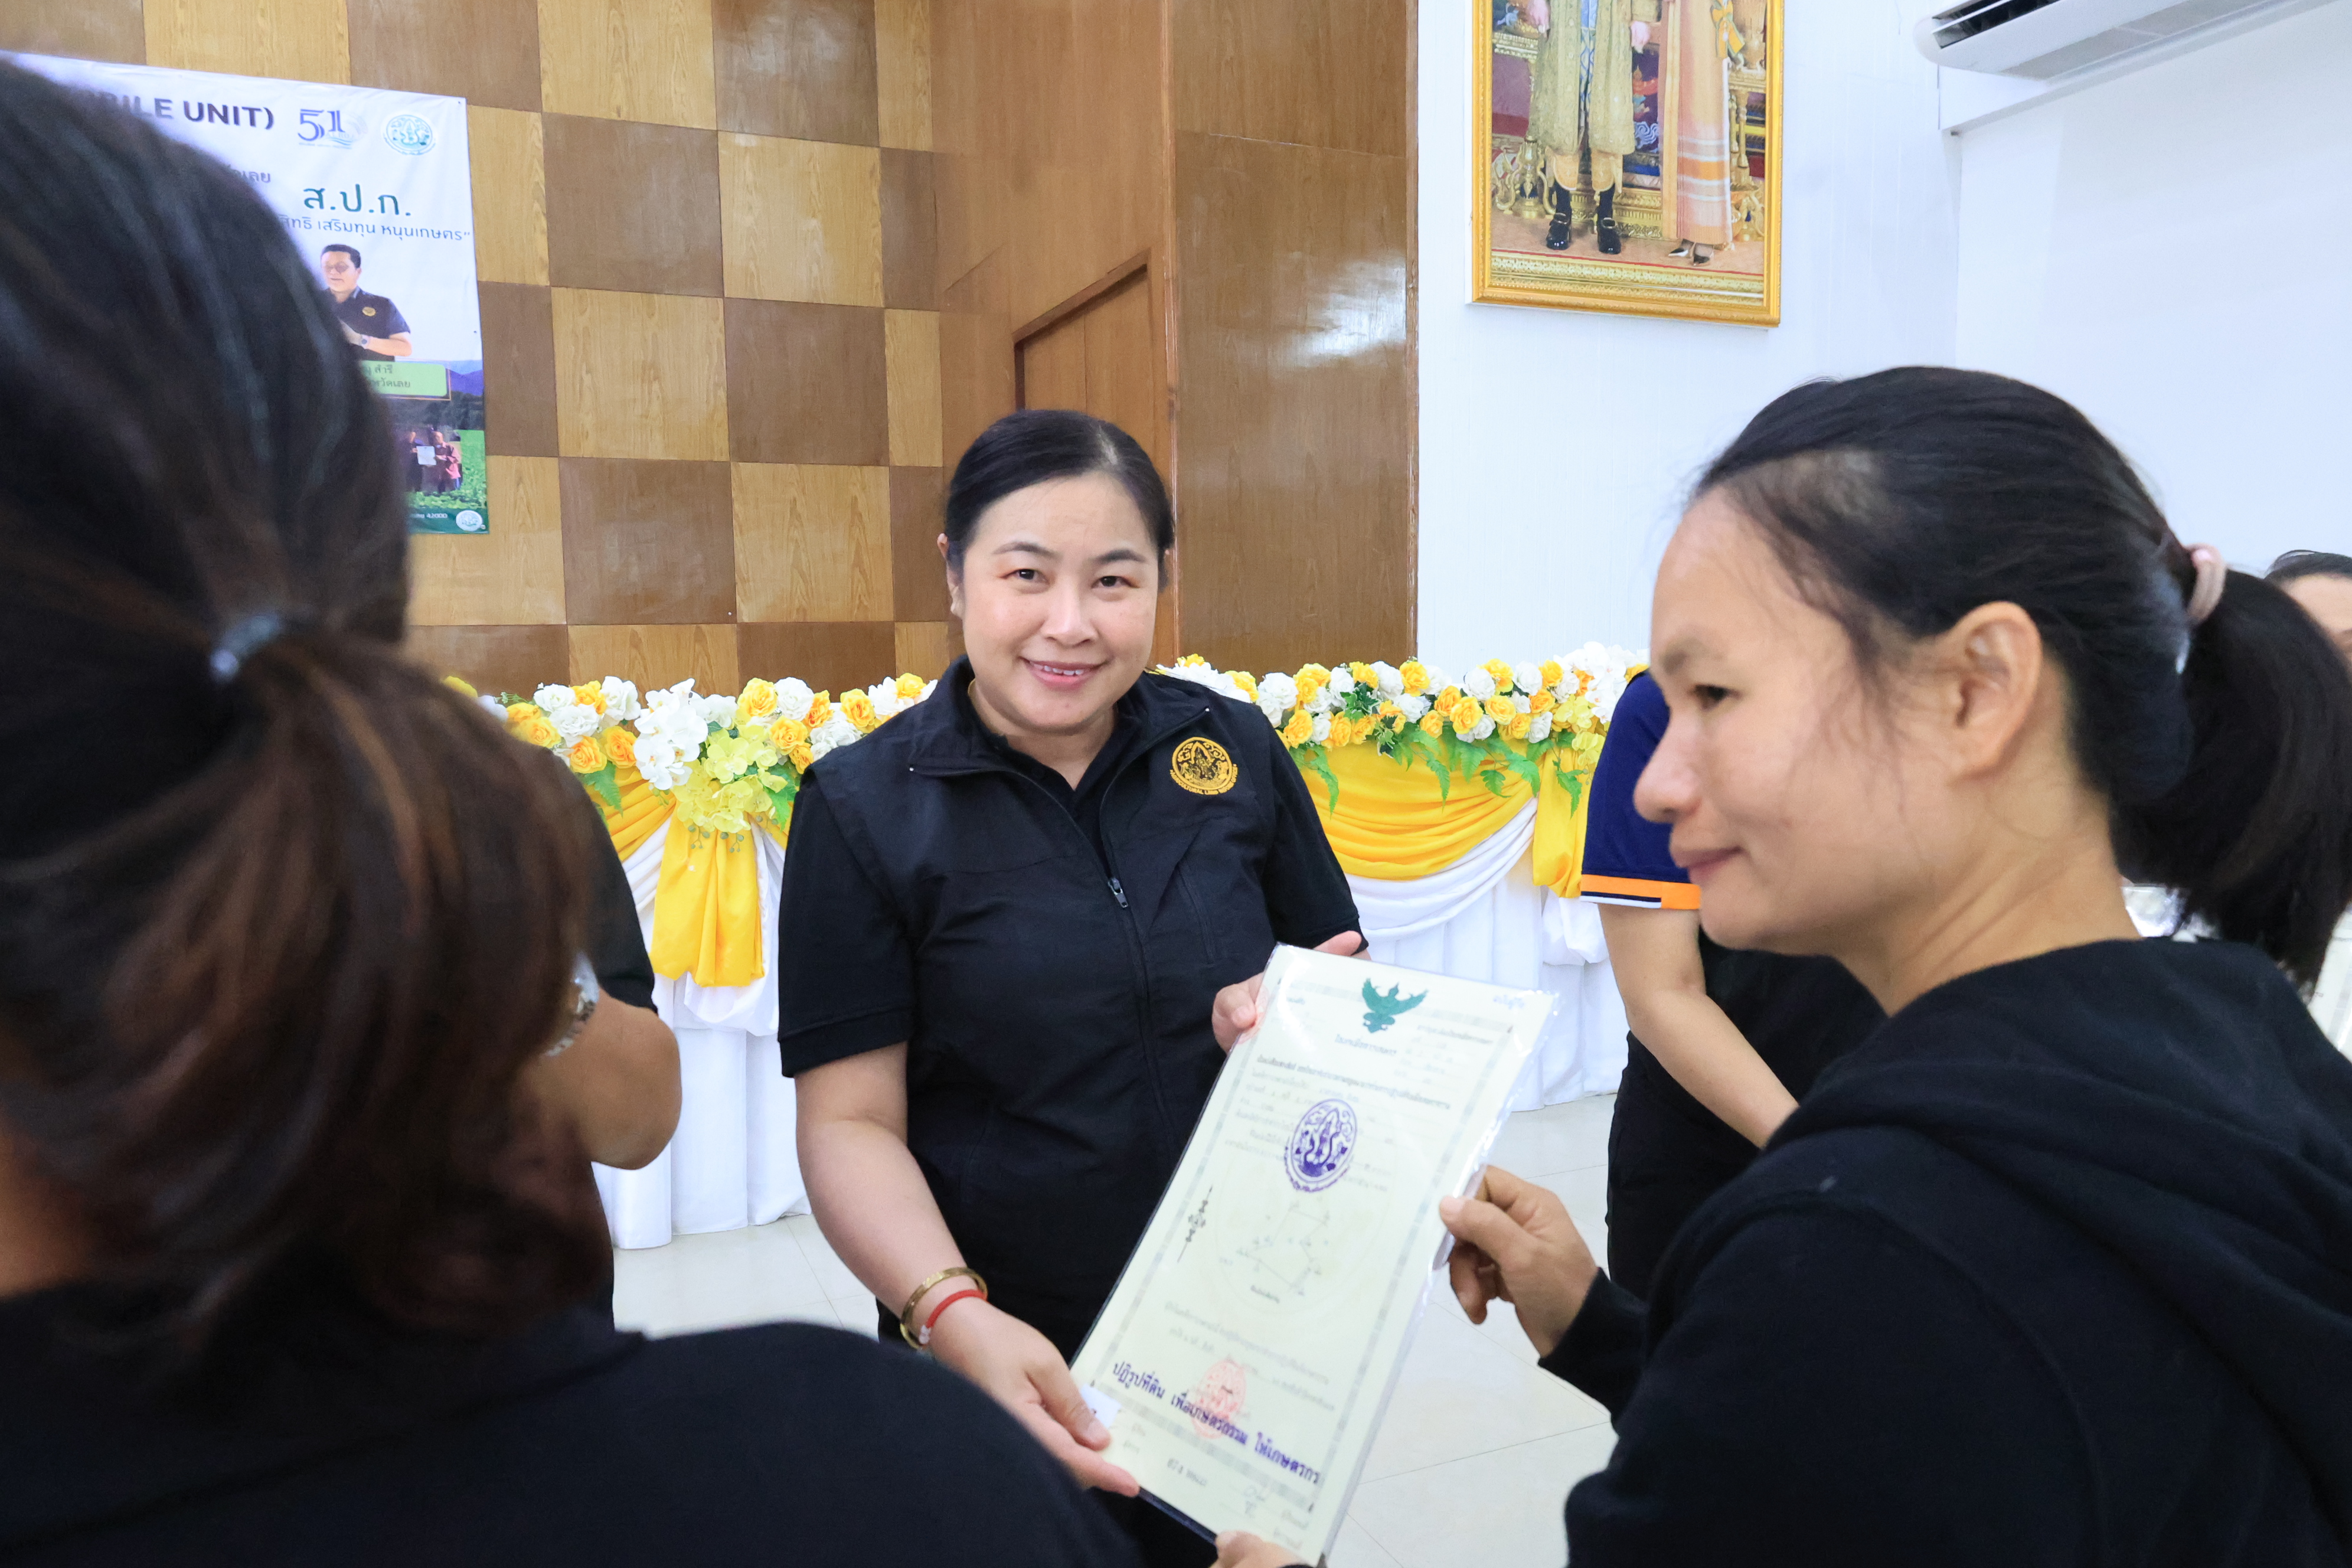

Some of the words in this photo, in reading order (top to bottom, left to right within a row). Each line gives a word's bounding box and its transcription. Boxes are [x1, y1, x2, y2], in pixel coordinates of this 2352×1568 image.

[183, 100, 275, 130] UNIT)
[298, 109, 345, 142] 51
[303, 184, 411, 216] ส.ป.ก.
[318, 219, 375, 237] เสริมทุน
